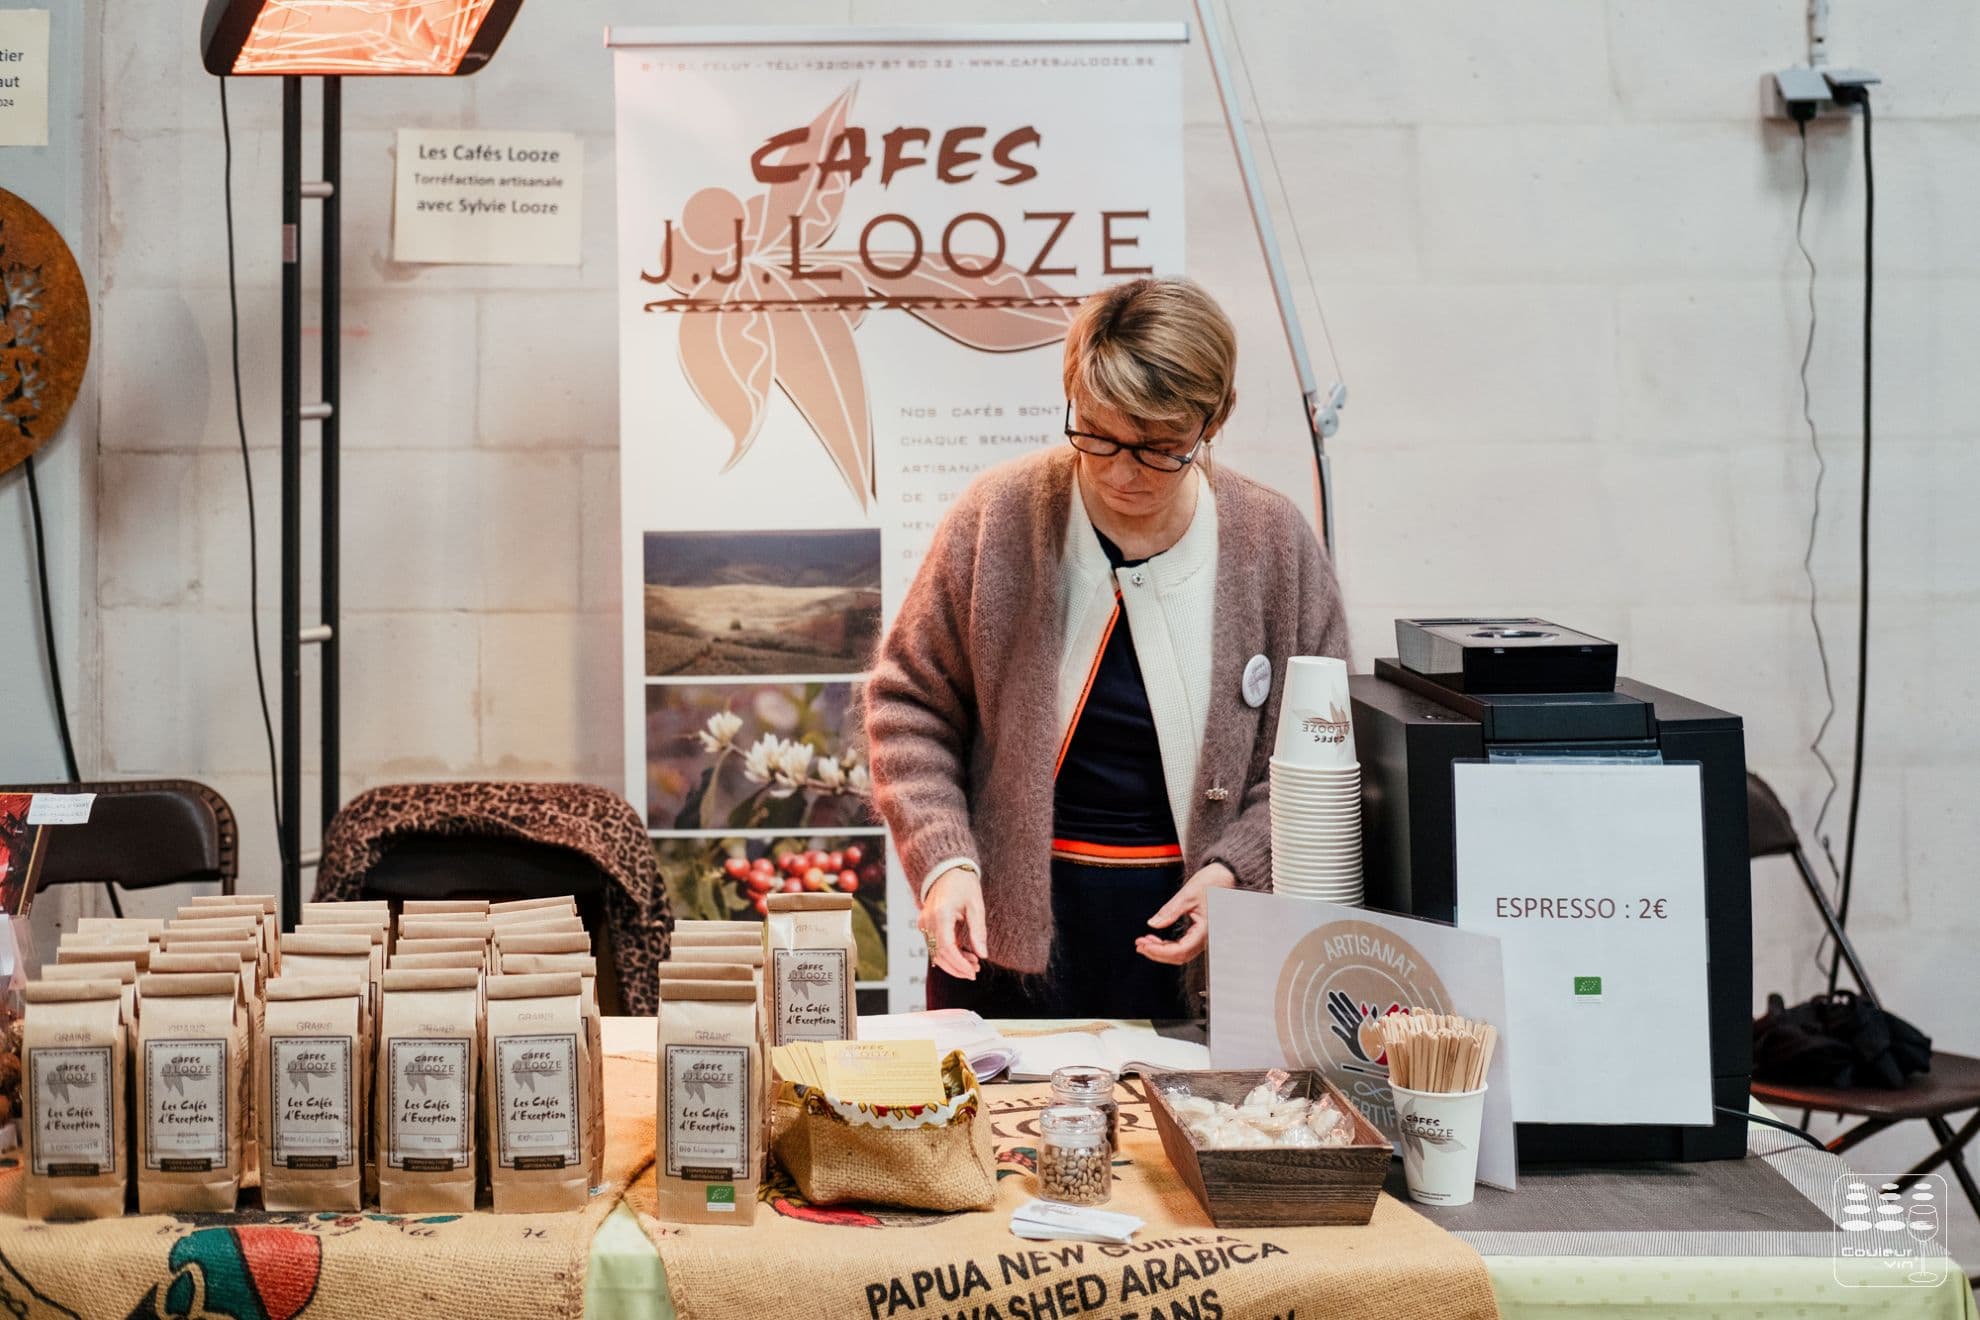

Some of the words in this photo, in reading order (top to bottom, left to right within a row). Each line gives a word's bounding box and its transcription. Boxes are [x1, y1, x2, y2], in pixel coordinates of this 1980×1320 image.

[419, 145, 447, 160] Les
[453, 144, 502, 161] Cafés
[508, 147, 560, 163] Looze
[750, 125, 1041, 191] CAFES
[414, 172, 495, 187] Torréfaction
[499, 175, 563, 188] artisanale
[416, 200, 453, 212] avec
[459, 198, 506, 215] Sylvie
[511, 201, 559, 215] Looze
[1018, 406, 1062, 417] SONT
[900, 435, 969, 447] CHAQUE
[979, 434, 1049, 446] SEMAINE
[1495, 897, 1616, 919] ESPRESSO
[1638, 898, 1668, 919] 2€
[1323, 933, 1418, 980] ARTISANAT
[789, 1003, 803, 1013] Les
[806, 1003, 830, 1014] Cafés
[786, 1015, 836, 1027] d'Exception
[161, 1100, 176, 1111] Les
[180, 1099, 208, 1113] Cafés
[287, 1097, 303, 1107] Les
[306, 1097, 333, 1110] Cafés
[404, 1099, 420, 1109] Les
[423, 1098, 450, 1112] Cafés
[513, 1097, 529, 1108] Les
[532, 1096, 559, 1109] Cafés
[48, 1107, 63, 1118] Les
[66, 1106, 94, 1120] Cafés
[158, 1113, 214, 1126] d'Exception
[284, 1110, 340, 1123] d'Exception
[401, 1112, 457, 1126] d'Exception
[510, 1109, 567, 1123] d'Exception
[682, 1107, 698, 1118] Les
[701, 1106, 729, 1120] Cafés
[44, 1120, 101, 1133] d'Exception
[679, 1120, 736, 1134] d'Exception
[864, 1260, 992, 1319] PAPUA
[999, 1244, 1085, 1285] NEW
[1098, 1235, 1241, 1258] GUINEA
[1119, 1242, 1290, 1302] ARABICA
